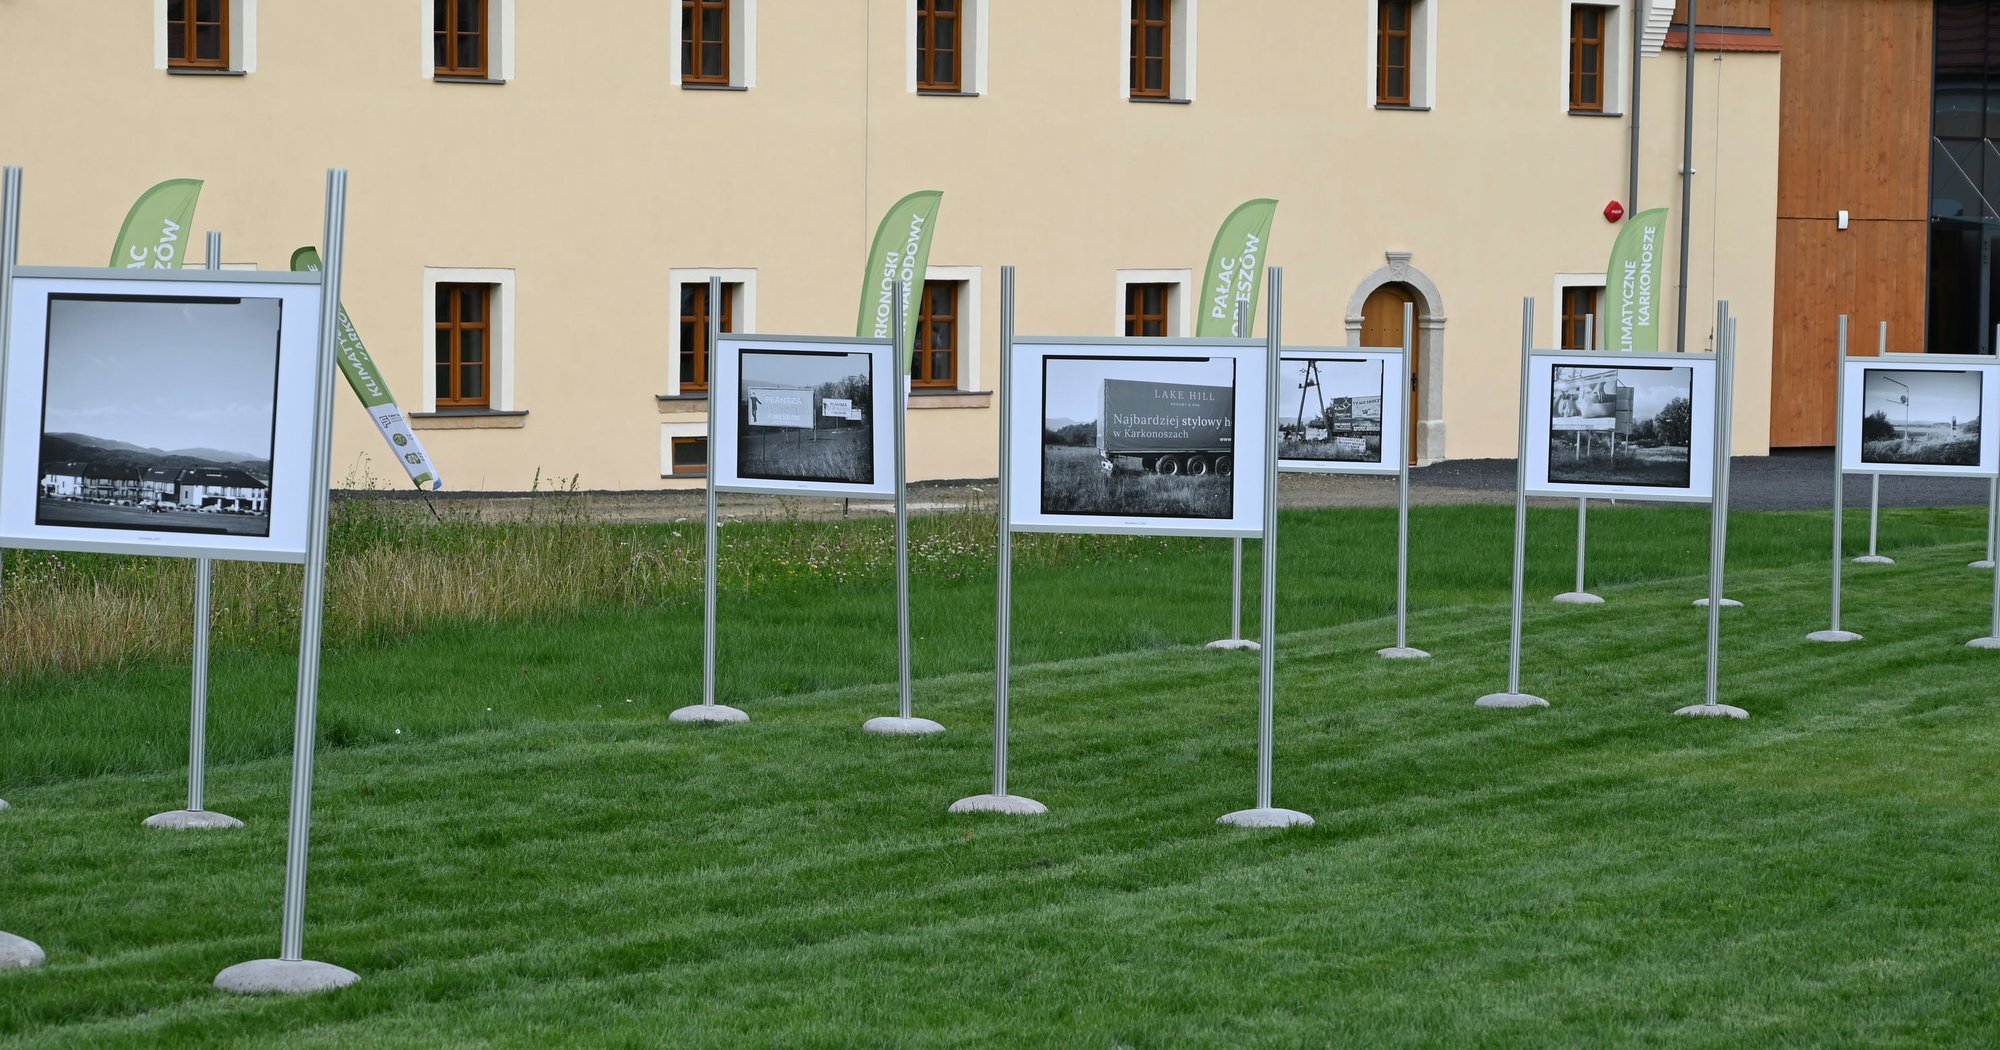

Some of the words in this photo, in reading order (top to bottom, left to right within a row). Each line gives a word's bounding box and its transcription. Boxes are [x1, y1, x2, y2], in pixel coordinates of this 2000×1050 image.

[874, 251, 900, 338] RKONOSKI
[1212, 257, 1235, 319] PAŁAC
[1621, 260, 1636, 352] LIMATYCZNE
[1638, 226, 1656, 326] KARKONOSZE
[1113, 413, 1179, 428] Najbardziej
[1182, 416, 1222, 429] stylowy
[1154, 389, 1184, 400] LAKE
[1189, 391, 1215, 401] HILL
[1124, 429, 1189, 439] Karkonoszach
